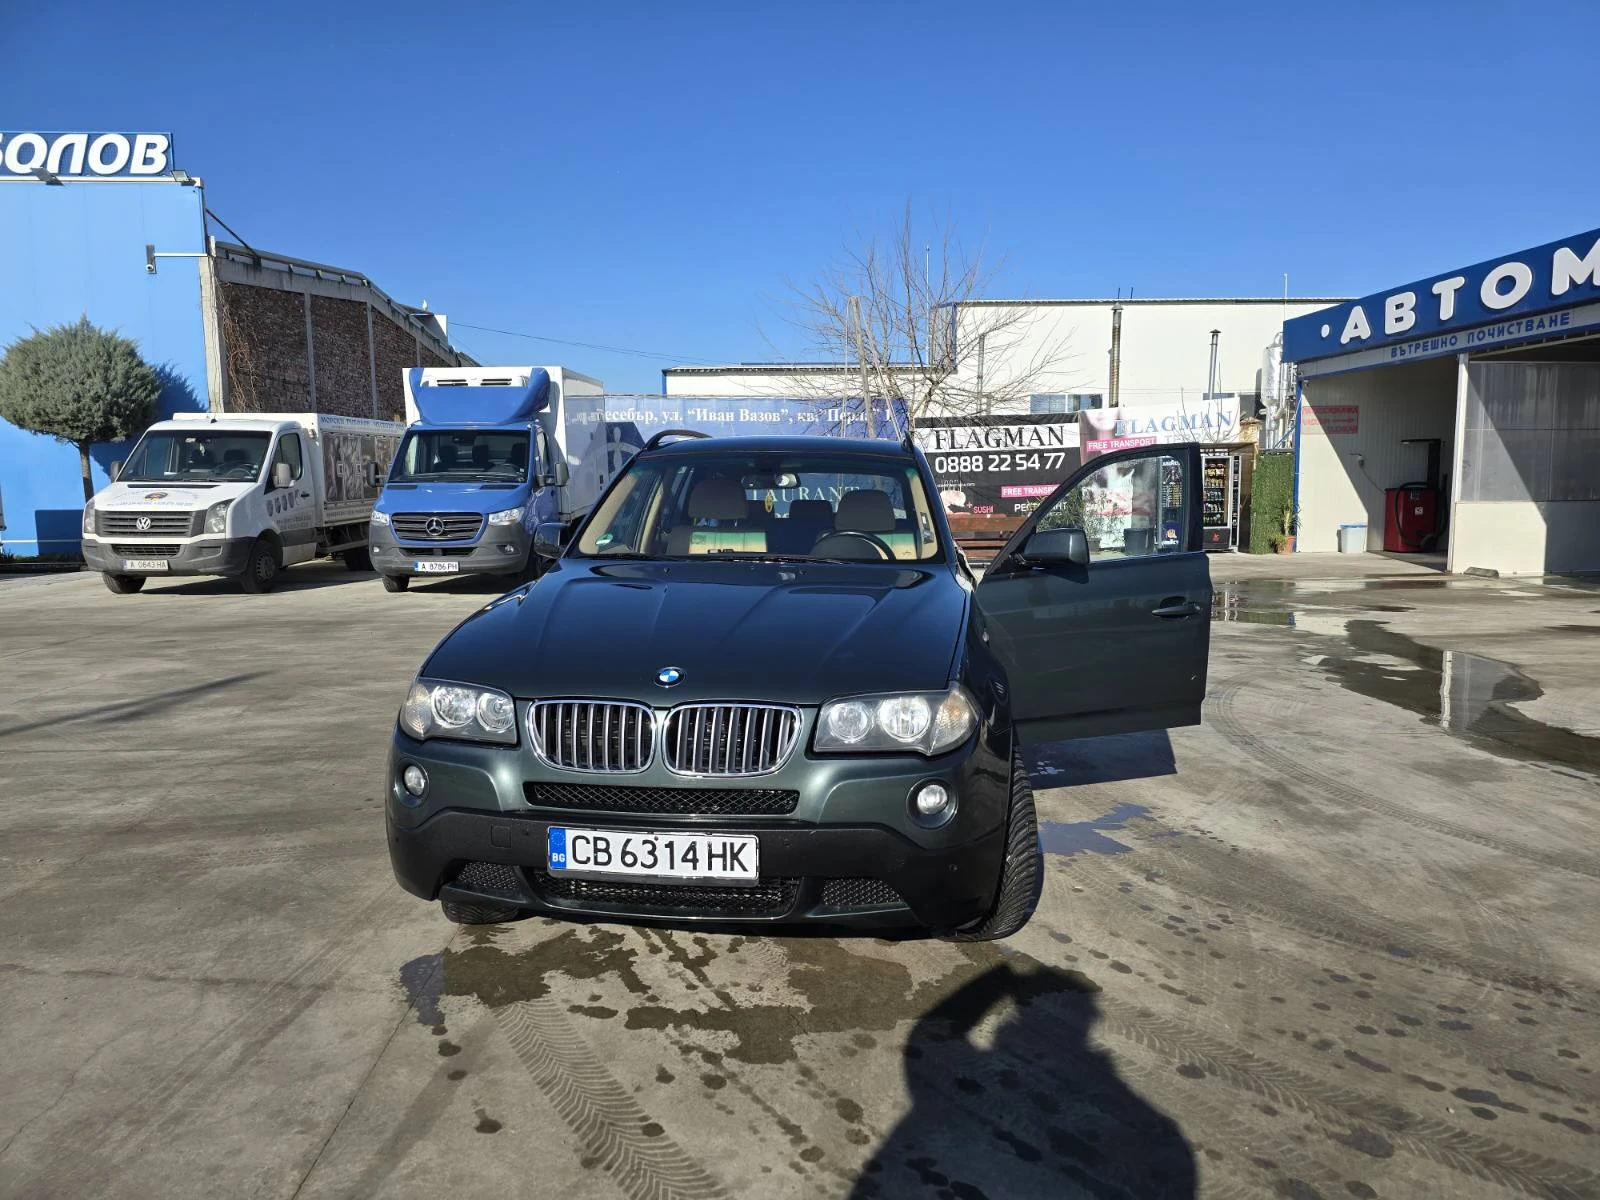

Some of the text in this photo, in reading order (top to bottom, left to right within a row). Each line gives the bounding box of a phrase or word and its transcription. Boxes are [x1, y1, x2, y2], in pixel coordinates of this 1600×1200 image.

[0, 133, 169, 175] ОЛОВ
[1391, 312, 1570, 358] ВЪТРЕШНО ПОЧИСТВАНЕ
[662, 412, 683, 424] ул.
[1115, 410, 1233, 436] FLAGMAN
[934, 425, 1065, 450] FLAGMAN
[1088, 437, 1156, 449] FREE TRANSPORT
[935, 452, 1066, 473] 0888 22 54 77
[1003, 487, 1022, 497] FREE
[974, 505, 994, 514] SUSHI
[552, 853, 566, 862] BG
[571, 835, 749, 873] CB 6314 HK
